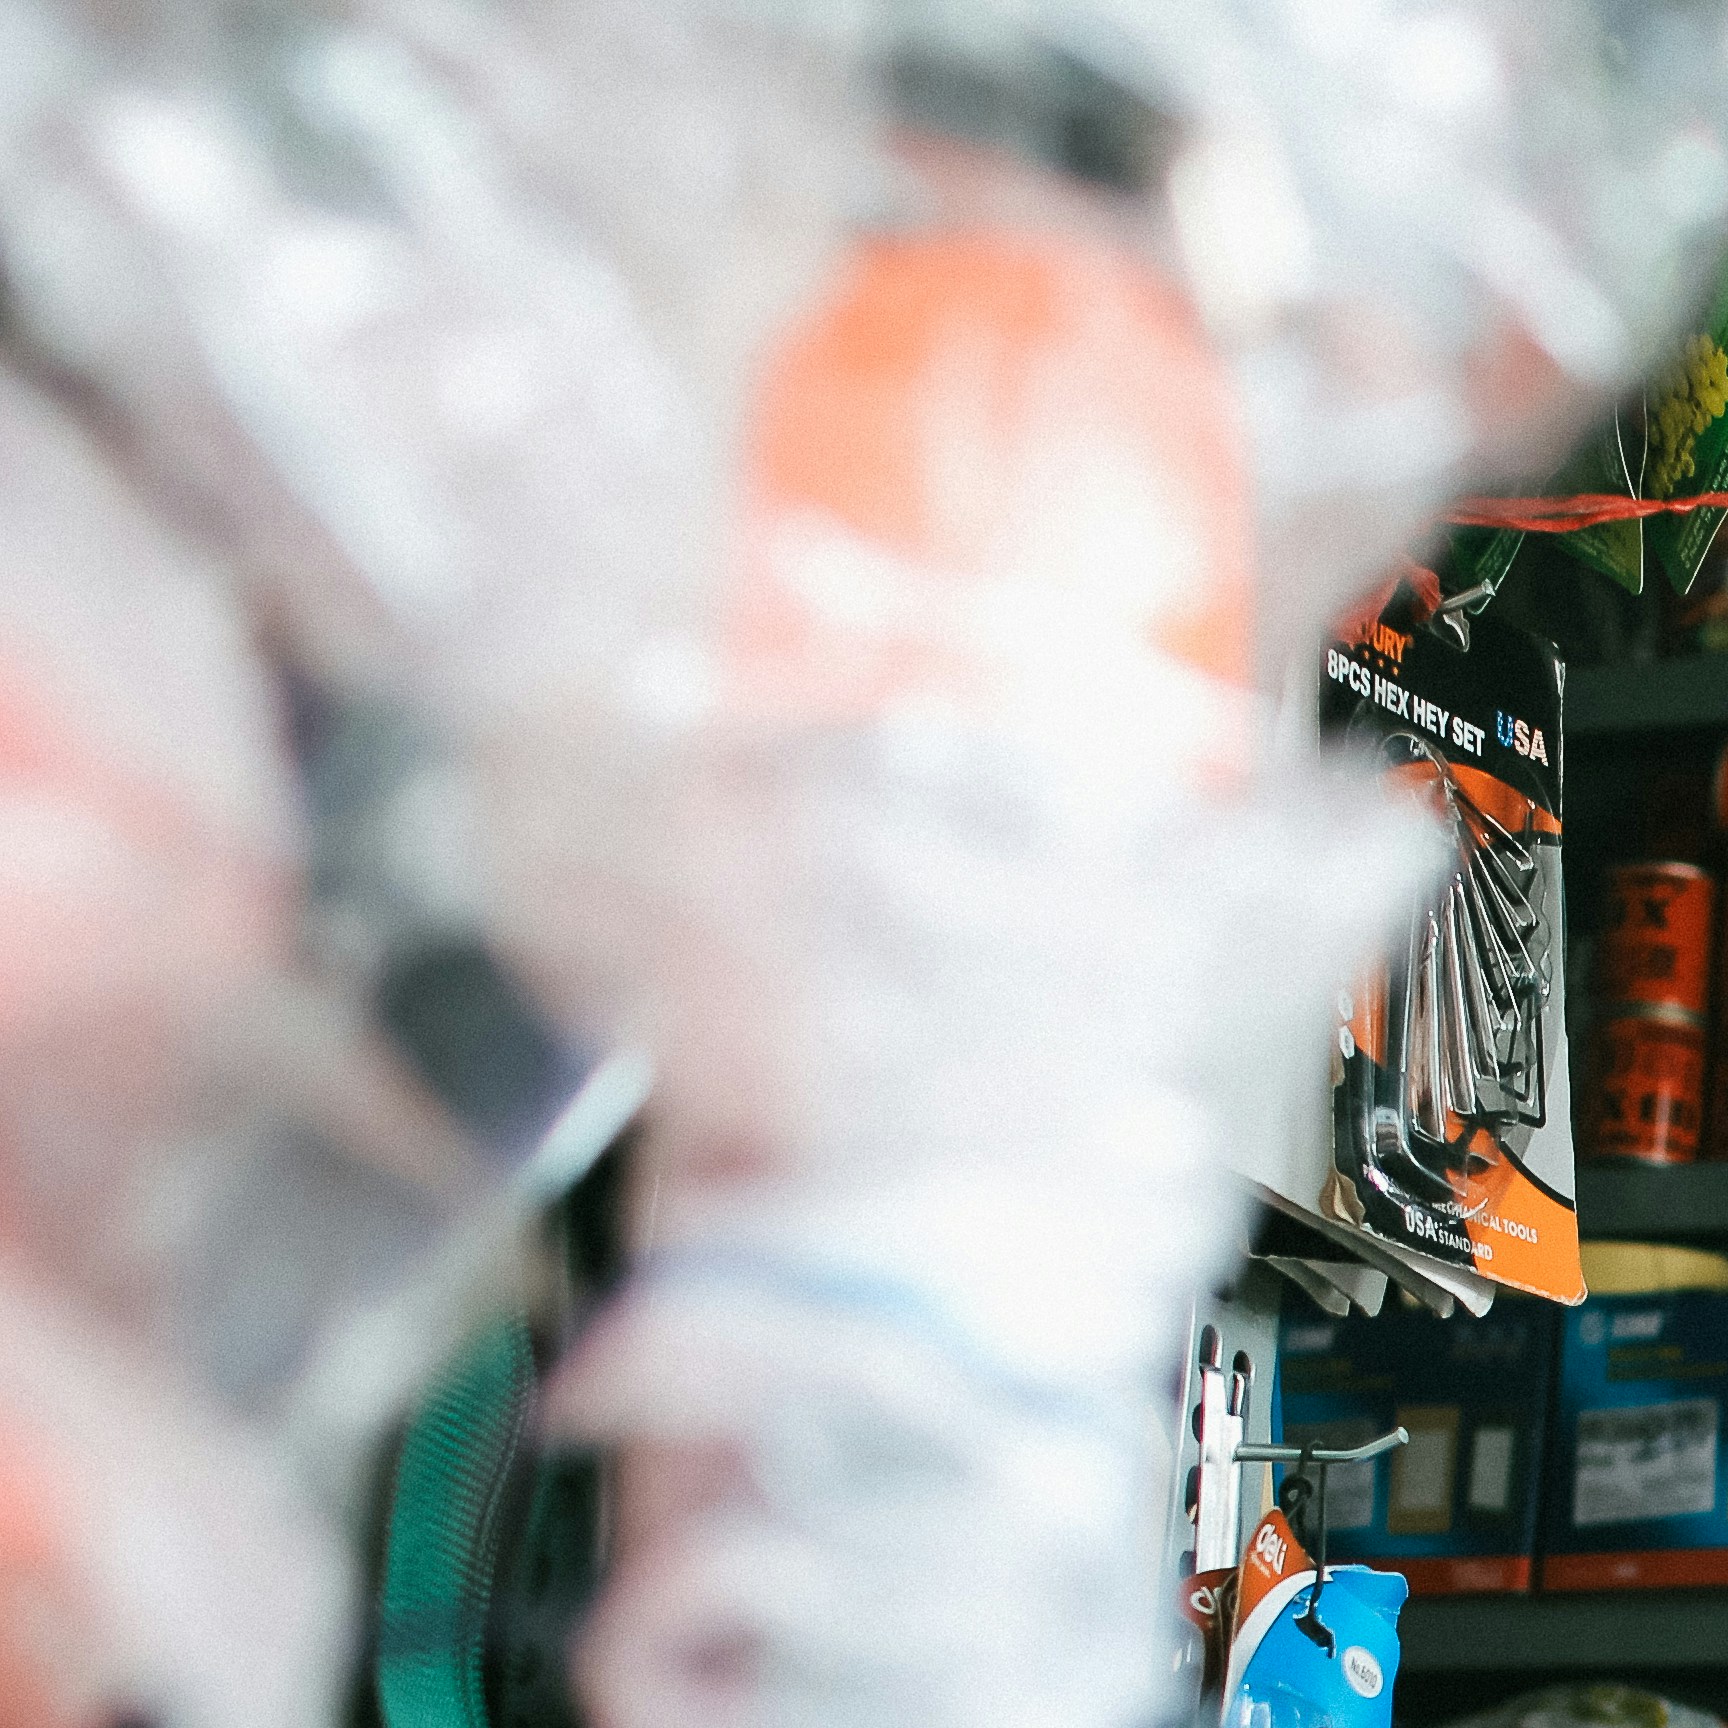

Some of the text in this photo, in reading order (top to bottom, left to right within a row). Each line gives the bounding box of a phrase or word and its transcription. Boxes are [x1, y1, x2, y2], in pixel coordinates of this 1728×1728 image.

[1326, 648, 1486, 757] 8PCS HEX HEY SET
[1495, 709, 1549, 767] USA
[1404, 1207, 1494, 1261] USA STANDARD
[1502, 1218, 1538, 1244] TOOLS
